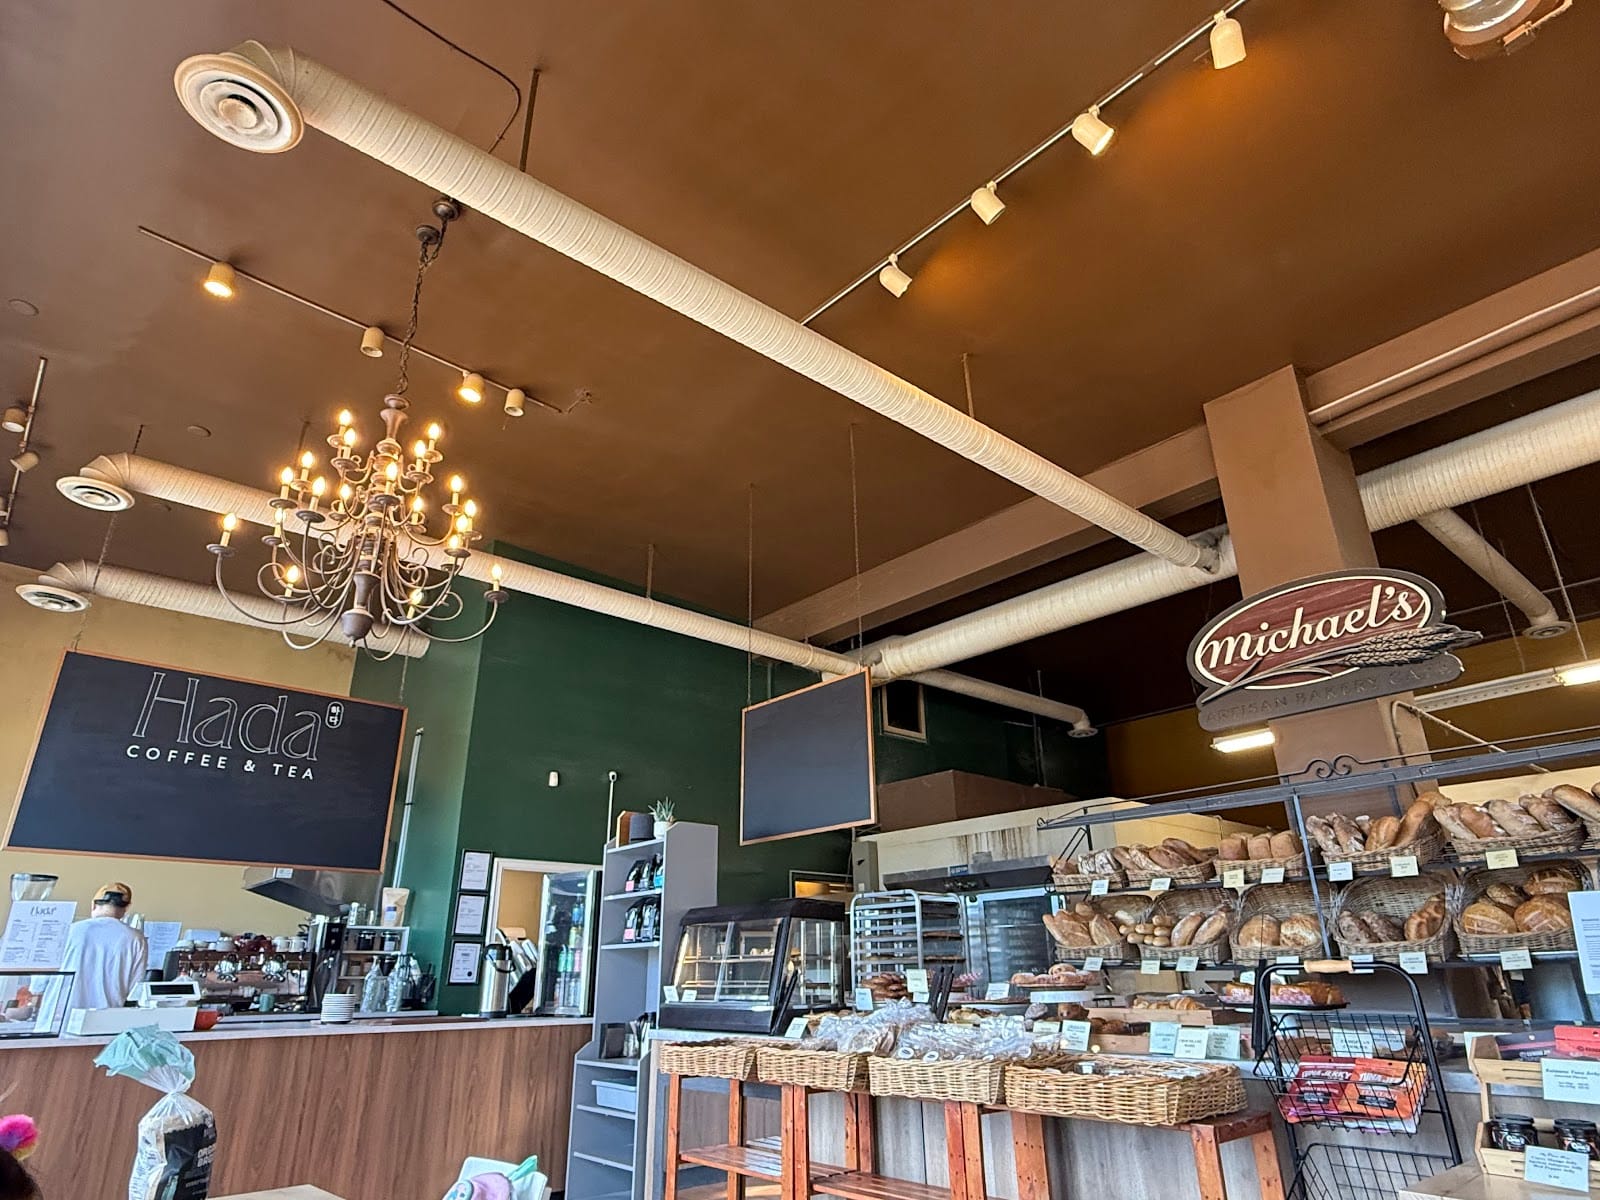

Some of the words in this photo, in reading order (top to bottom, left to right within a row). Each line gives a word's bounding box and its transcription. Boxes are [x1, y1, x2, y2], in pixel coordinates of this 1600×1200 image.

[1294, 677, 1378, 705] BAKERY
[132, 671, 322, 762] Hada
[126, 744, 228, 769] COFFEE
[243, 759, 256, 773] &
[273, 763, 315, 781] TEA
